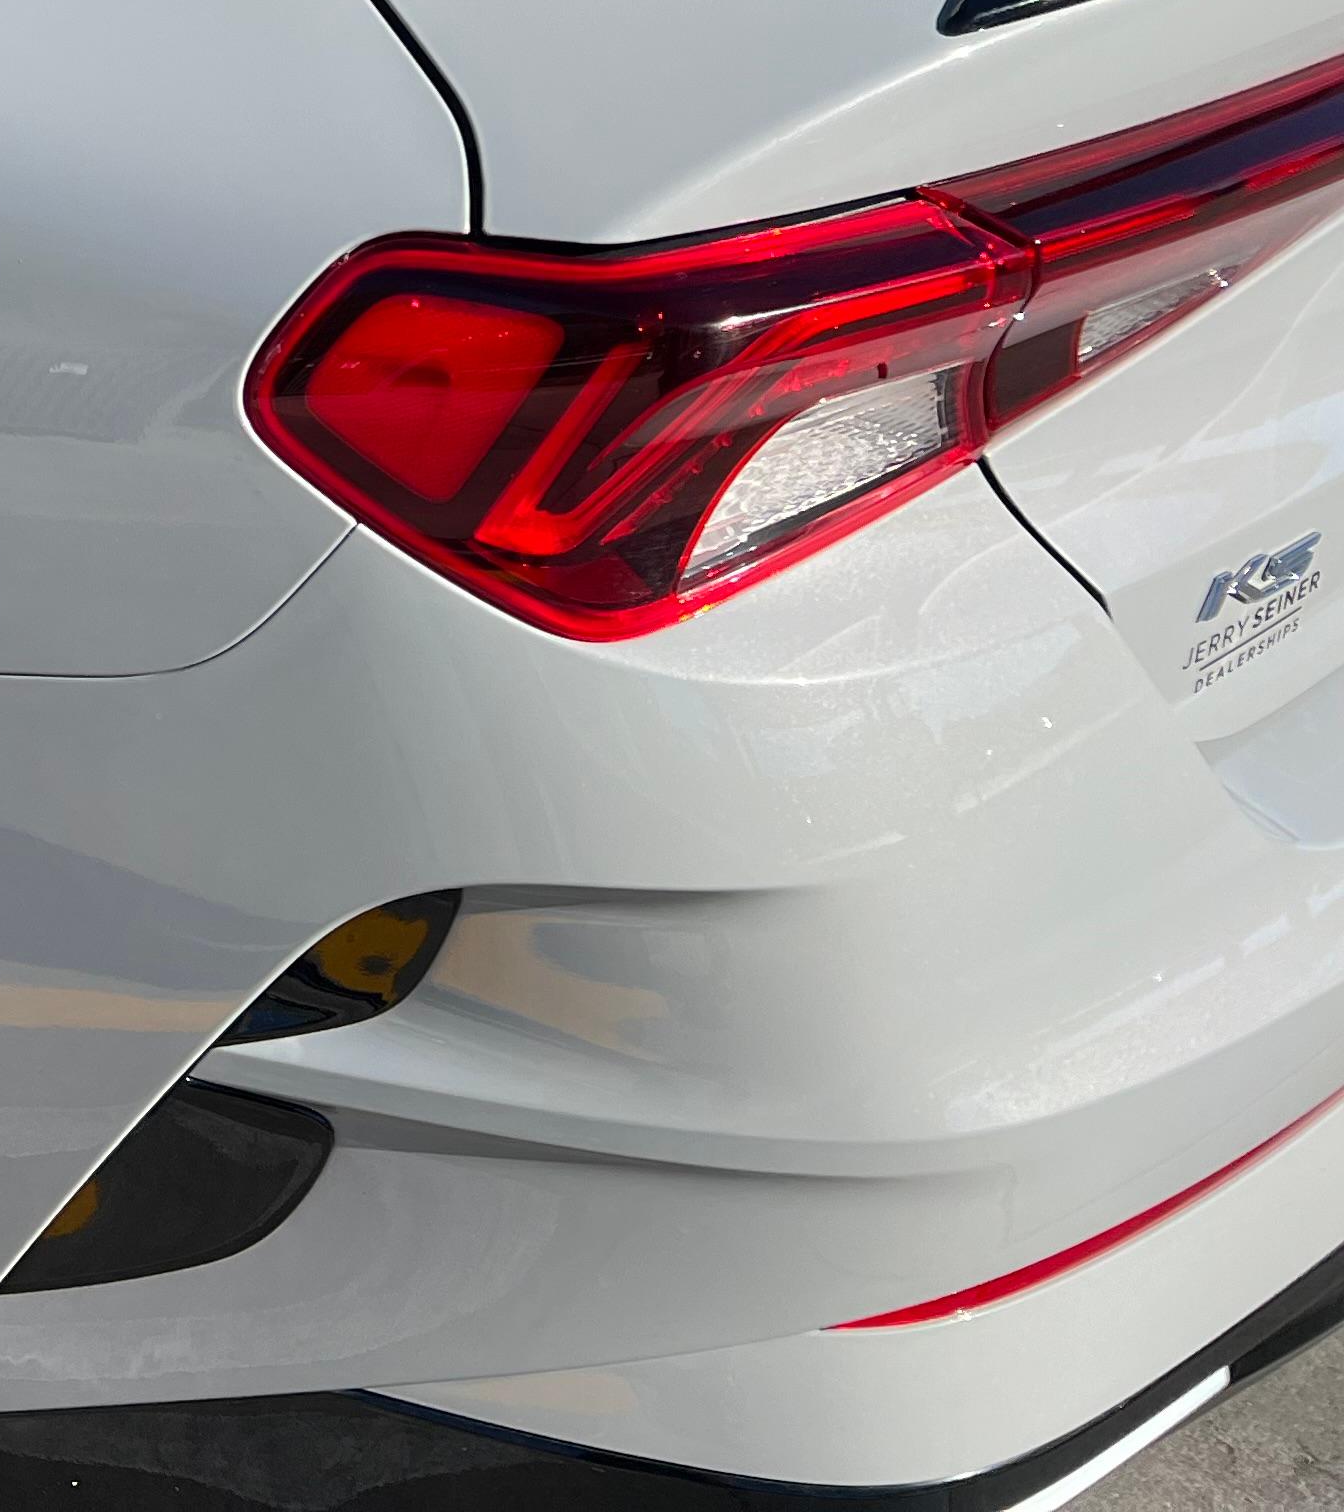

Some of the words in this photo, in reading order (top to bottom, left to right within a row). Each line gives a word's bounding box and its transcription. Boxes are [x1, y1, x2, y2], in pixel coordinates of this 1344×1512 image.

[1182, 616, 1249, 670] JERRY
[1252, 570, 1320, 629] SEINER
[1194, 618, 1300, 693] DEALERSHIPS
